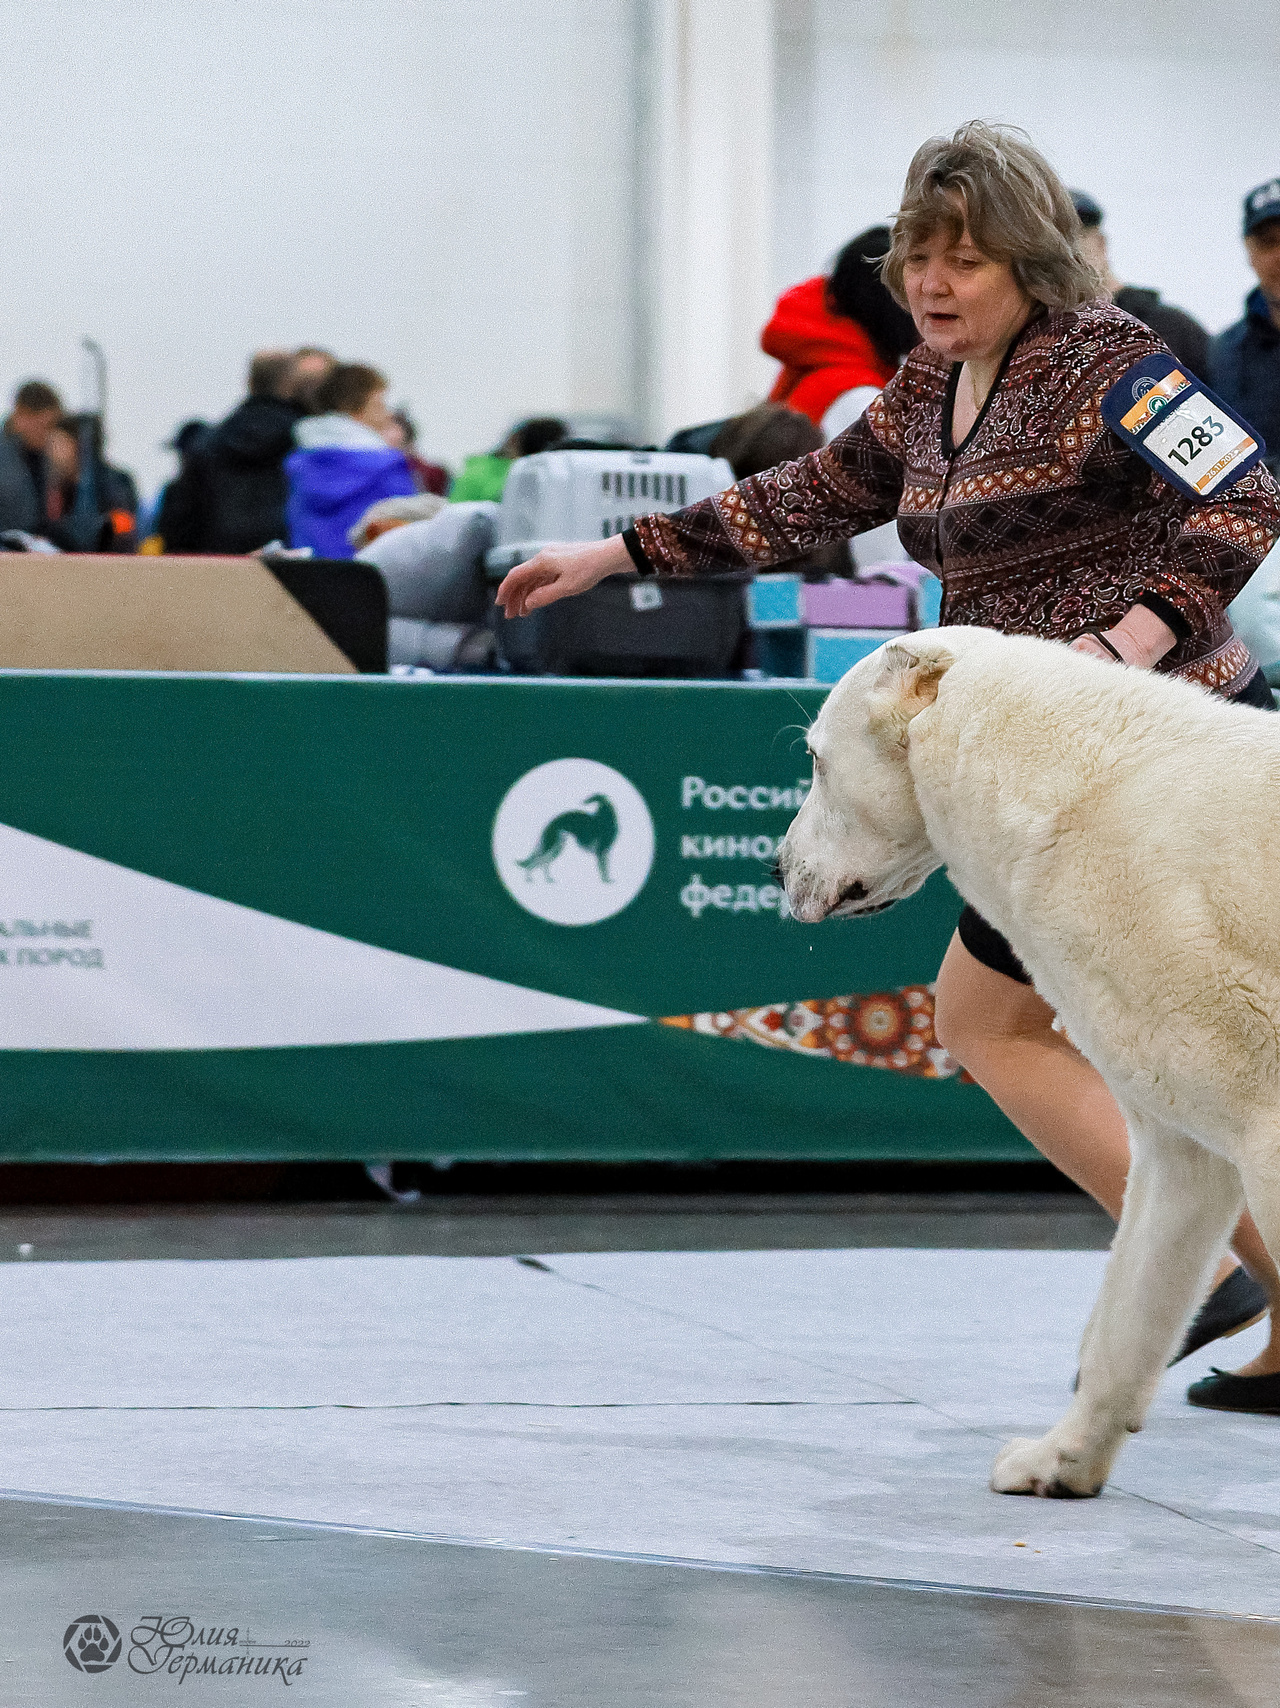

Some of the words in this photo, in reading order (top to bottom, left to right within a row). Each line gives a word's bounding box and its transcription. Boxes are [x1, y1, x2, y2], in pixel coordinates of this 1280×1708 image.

[1168, 415, 1225, 467] 1283
[1206, 449, 1239, 479] 26.11.202
[681, 834, 785, 859] кино
